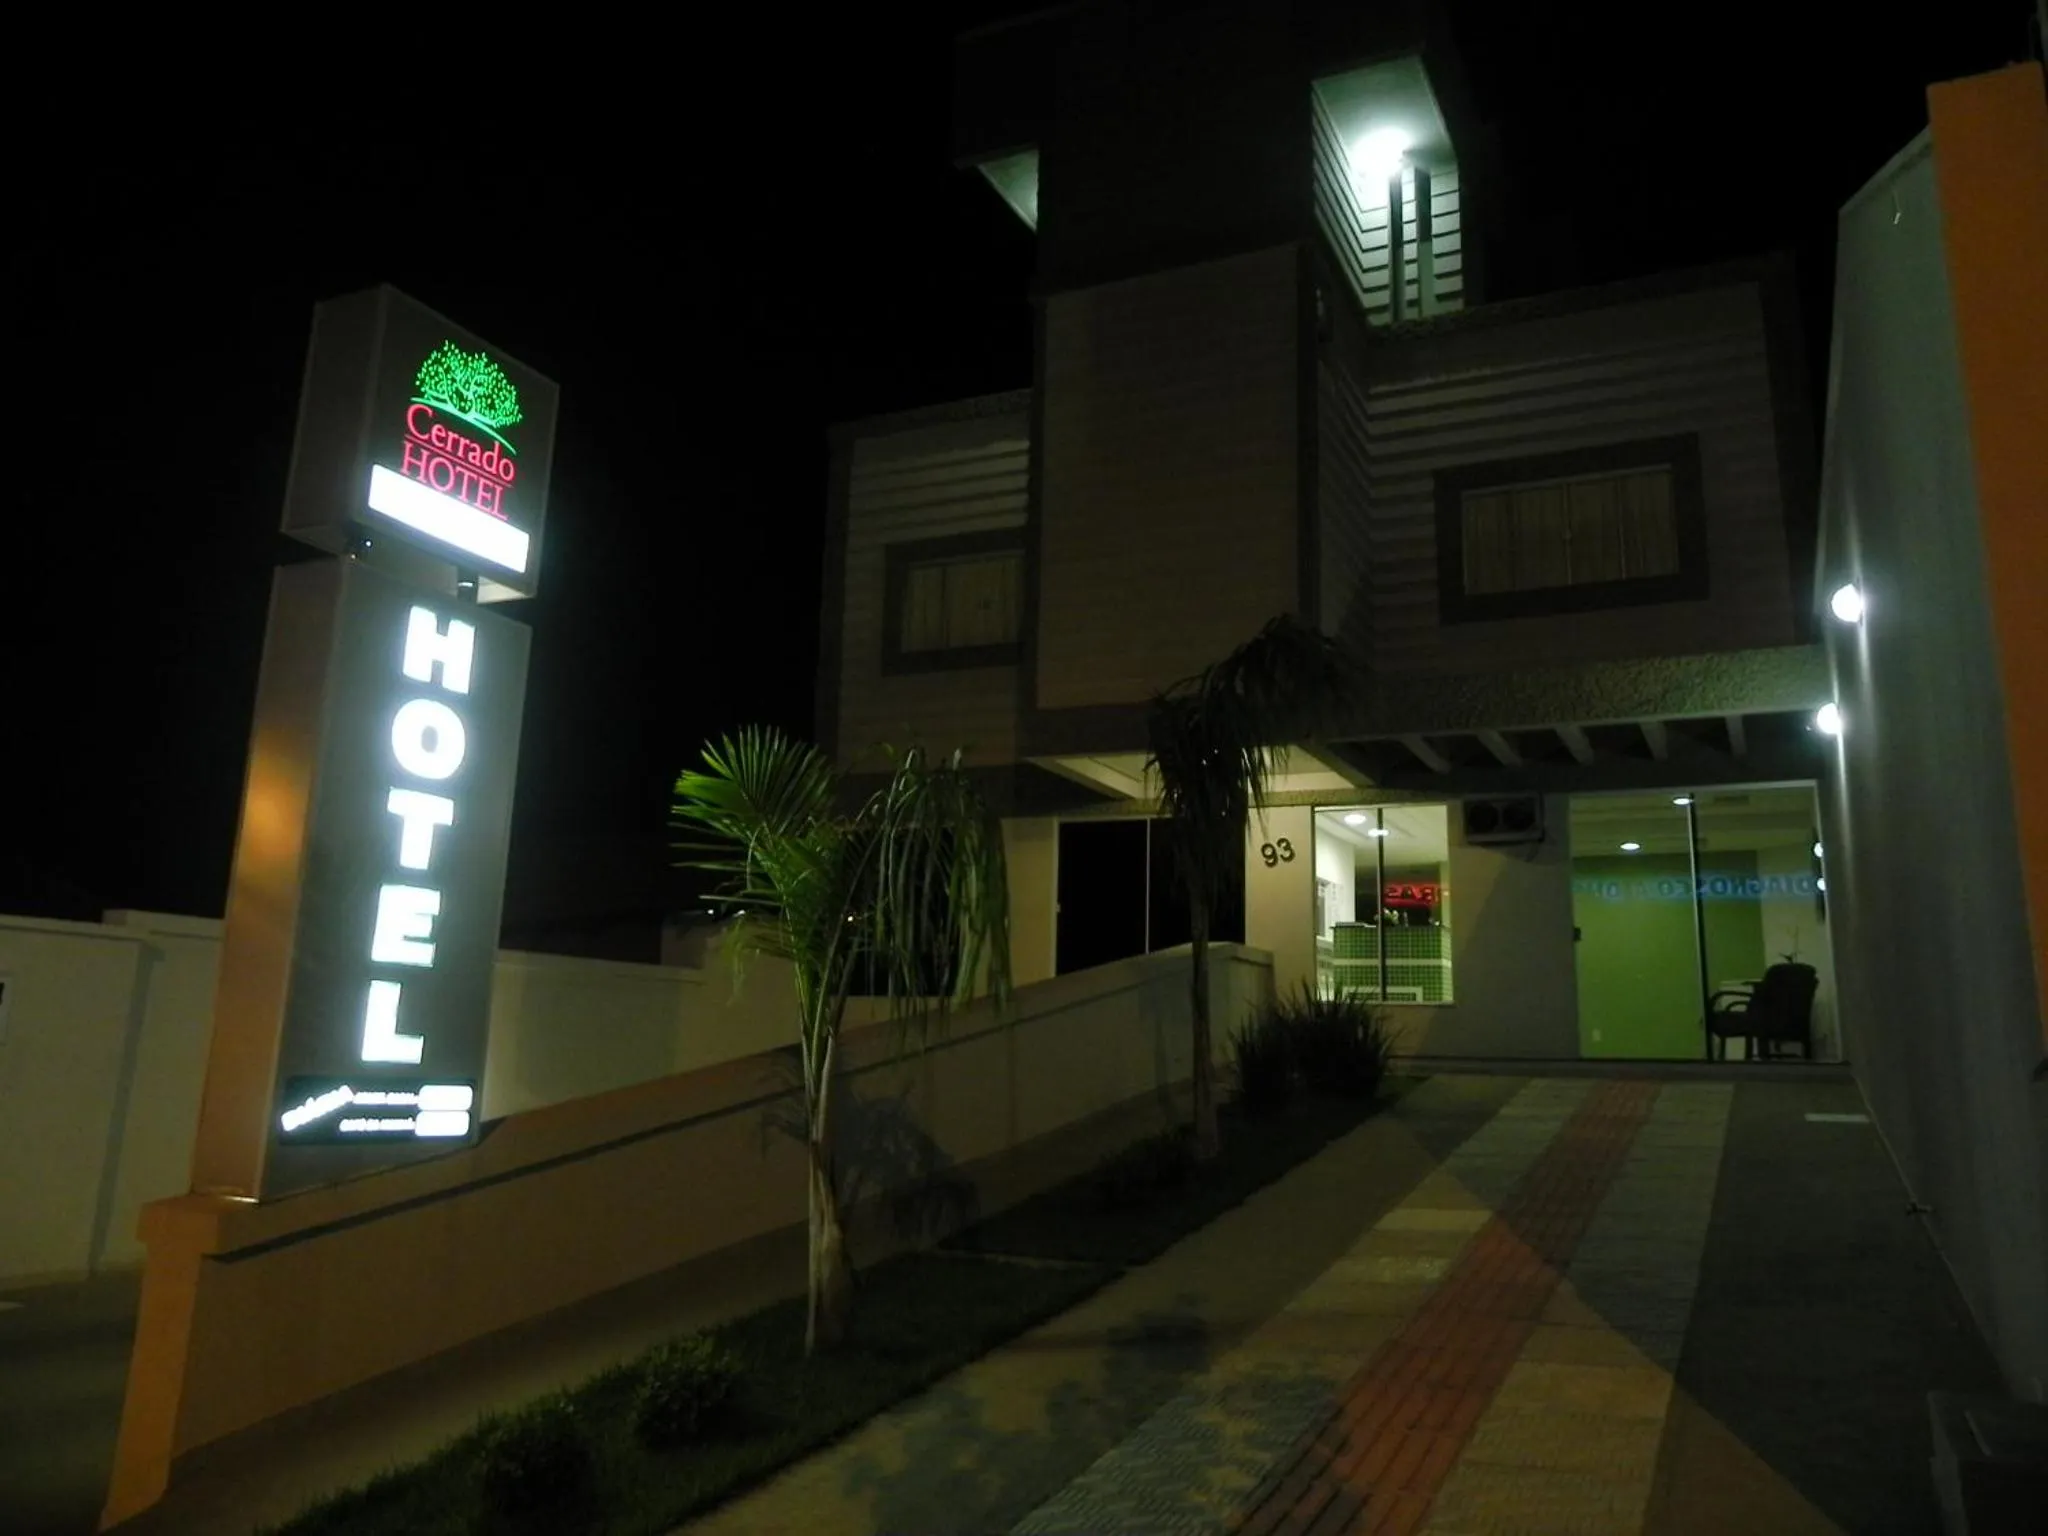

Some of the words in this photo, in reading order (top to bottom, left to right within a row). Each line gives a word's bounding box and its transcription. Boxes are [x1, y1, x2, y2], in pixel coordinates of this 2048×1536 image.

[400, 441, 509, 520] HOTEL
[406, 403, 515, 482] Cerrado
[361, 605, 477, 1066] HOTEL
[1260, 838, 1296, 868] 93
